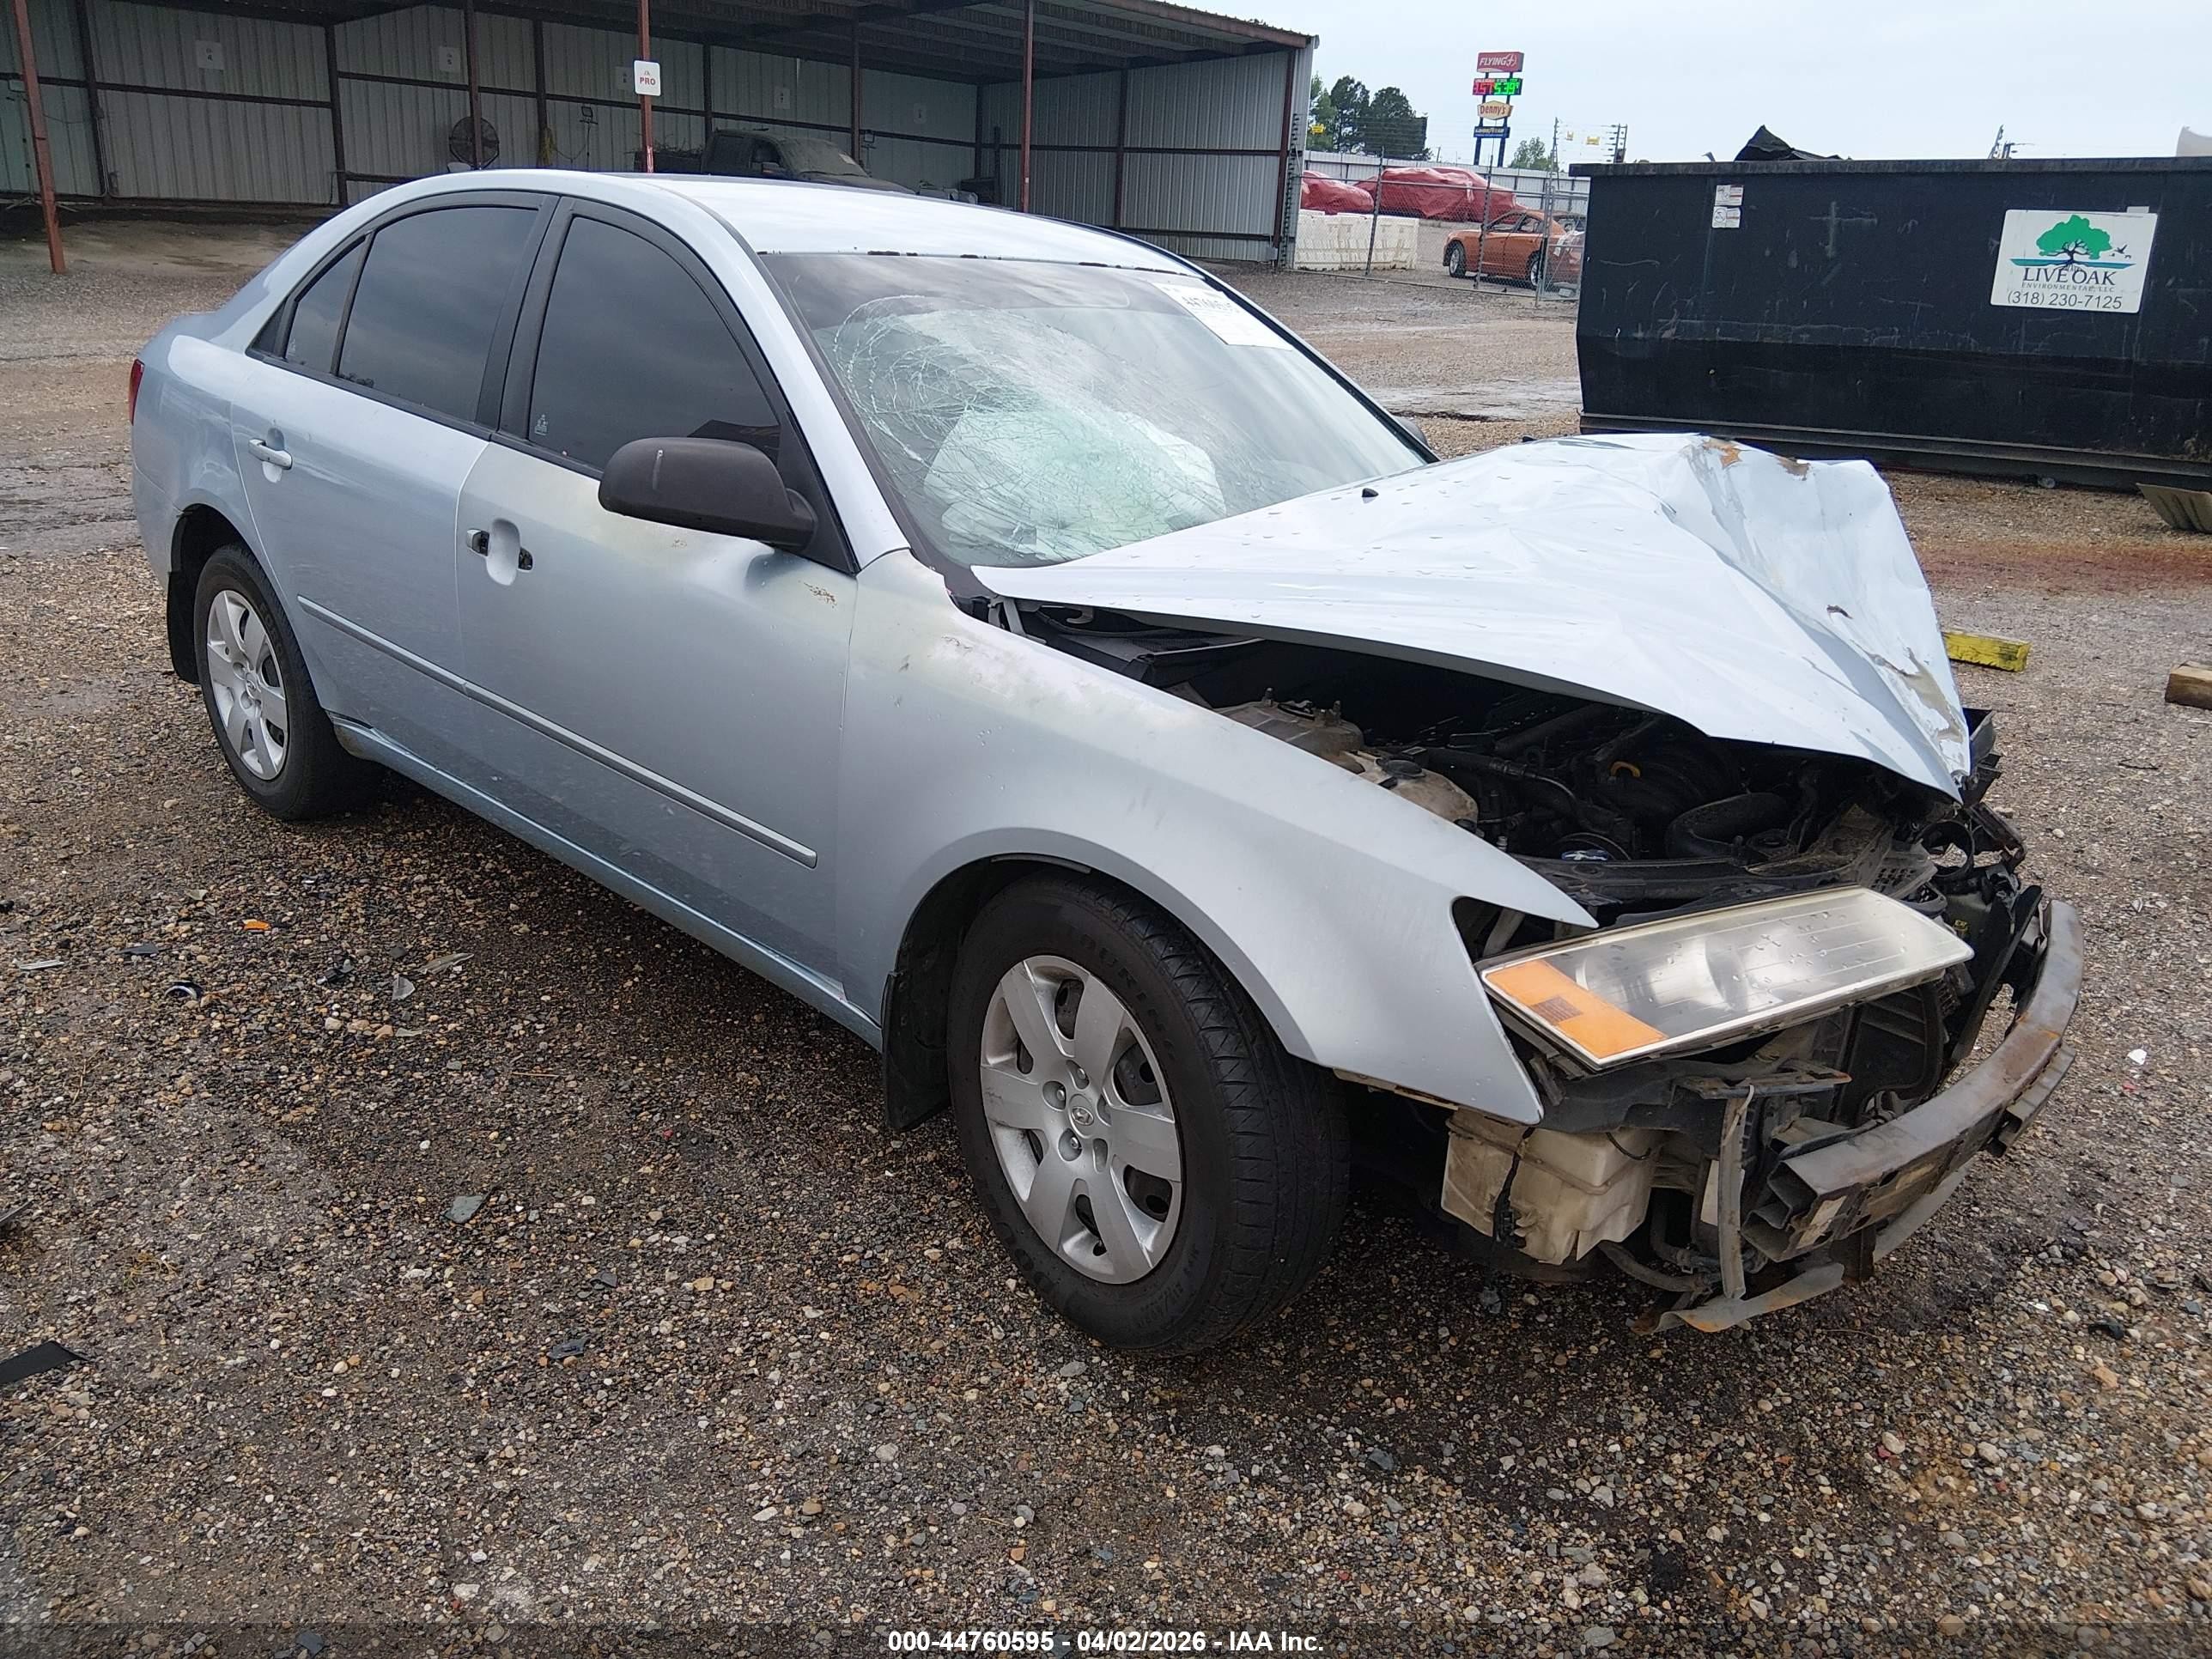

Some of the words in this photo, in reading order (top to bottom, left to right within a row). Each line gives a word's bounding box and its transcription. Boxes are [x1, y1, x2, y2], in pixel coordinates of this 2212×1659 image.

[1479, 56, 1506, 66] FLYING
[639, 76, 656, 86] PRO
[1480, 104, 1506, 115] Denny's
[2023, 267, 2069, 283] LIVE
[2071, 269, 2117, 286] OAK
[2008, 290, 2045, 305] (318)
[2049, 293, 2123, 309] 230-7125
